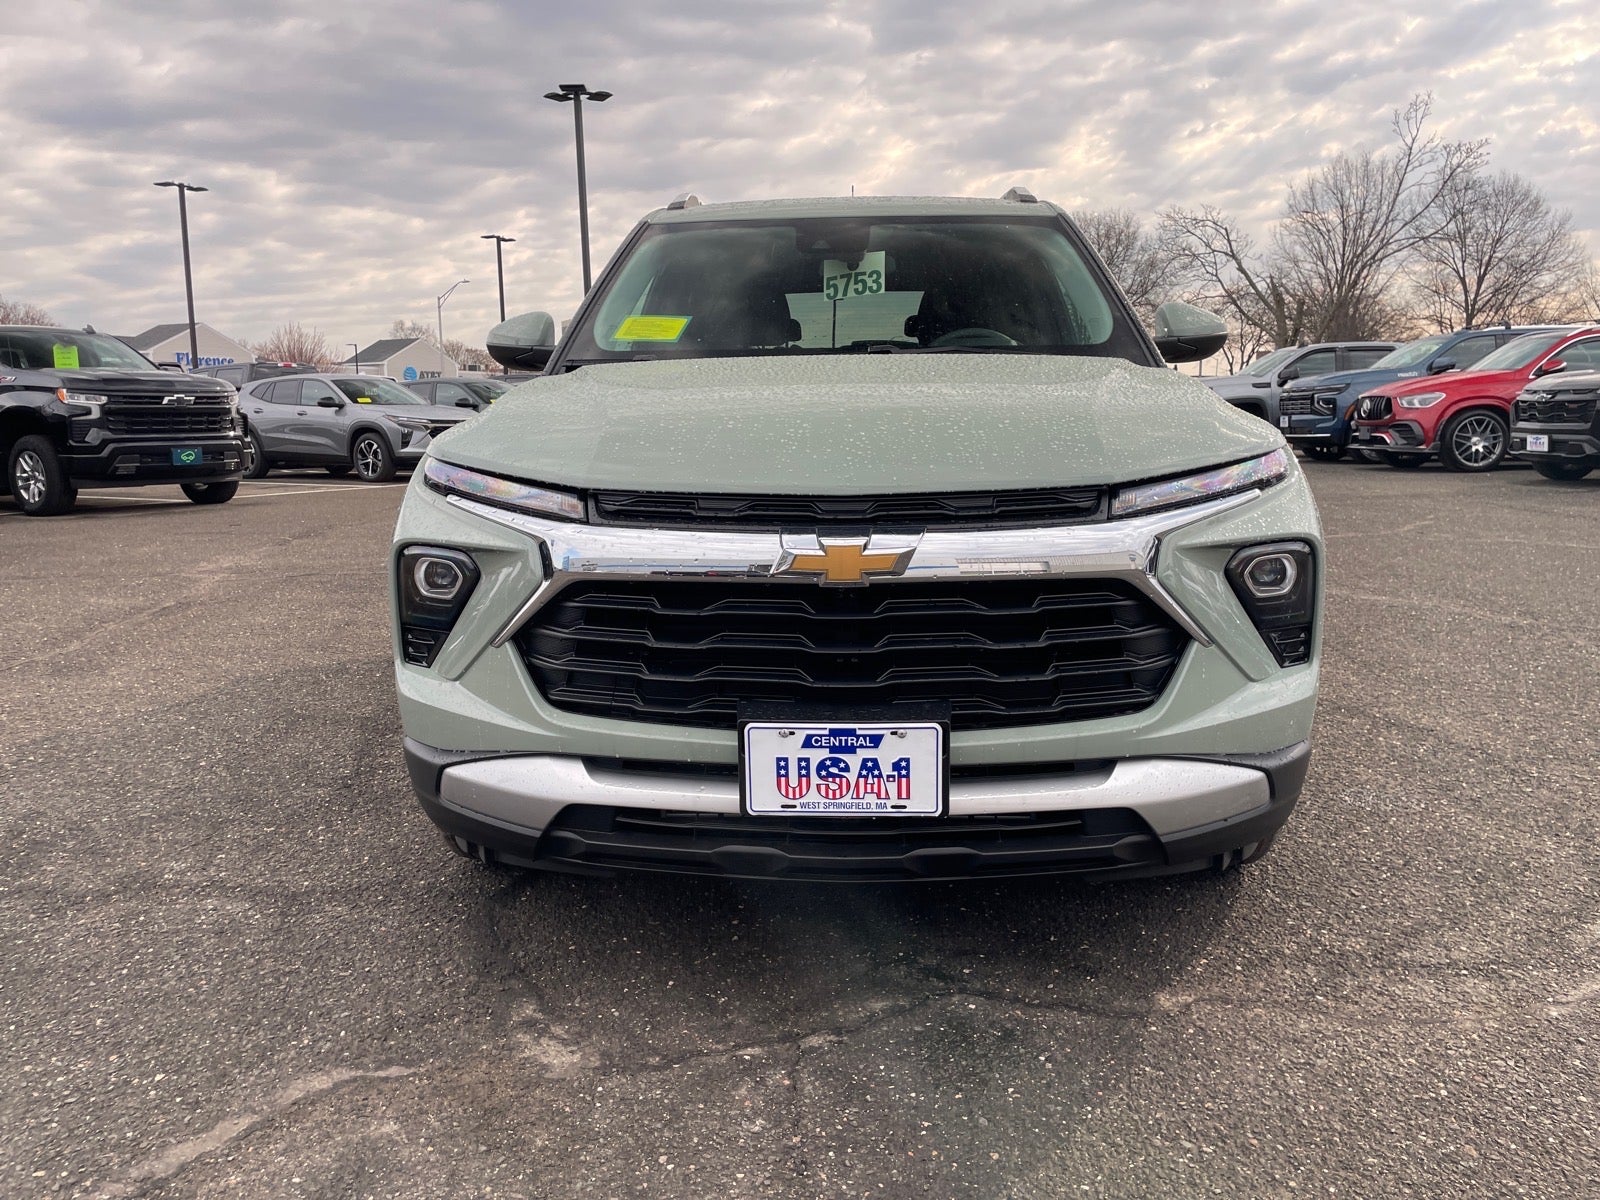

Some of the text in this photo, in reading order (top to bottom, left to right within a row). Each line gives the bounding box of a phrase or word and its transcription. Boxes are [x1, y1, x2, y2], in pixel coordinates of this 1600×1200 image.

[825, 269, 883, 301] 5753
[176, 352, 234, 366] Flrence
[811, 736, 875, 747] CENTRAL
[775, 757, 911, 800] USA-1
[799, 801, 821, 810] WEST
[875, 801, 888, 810] MA
